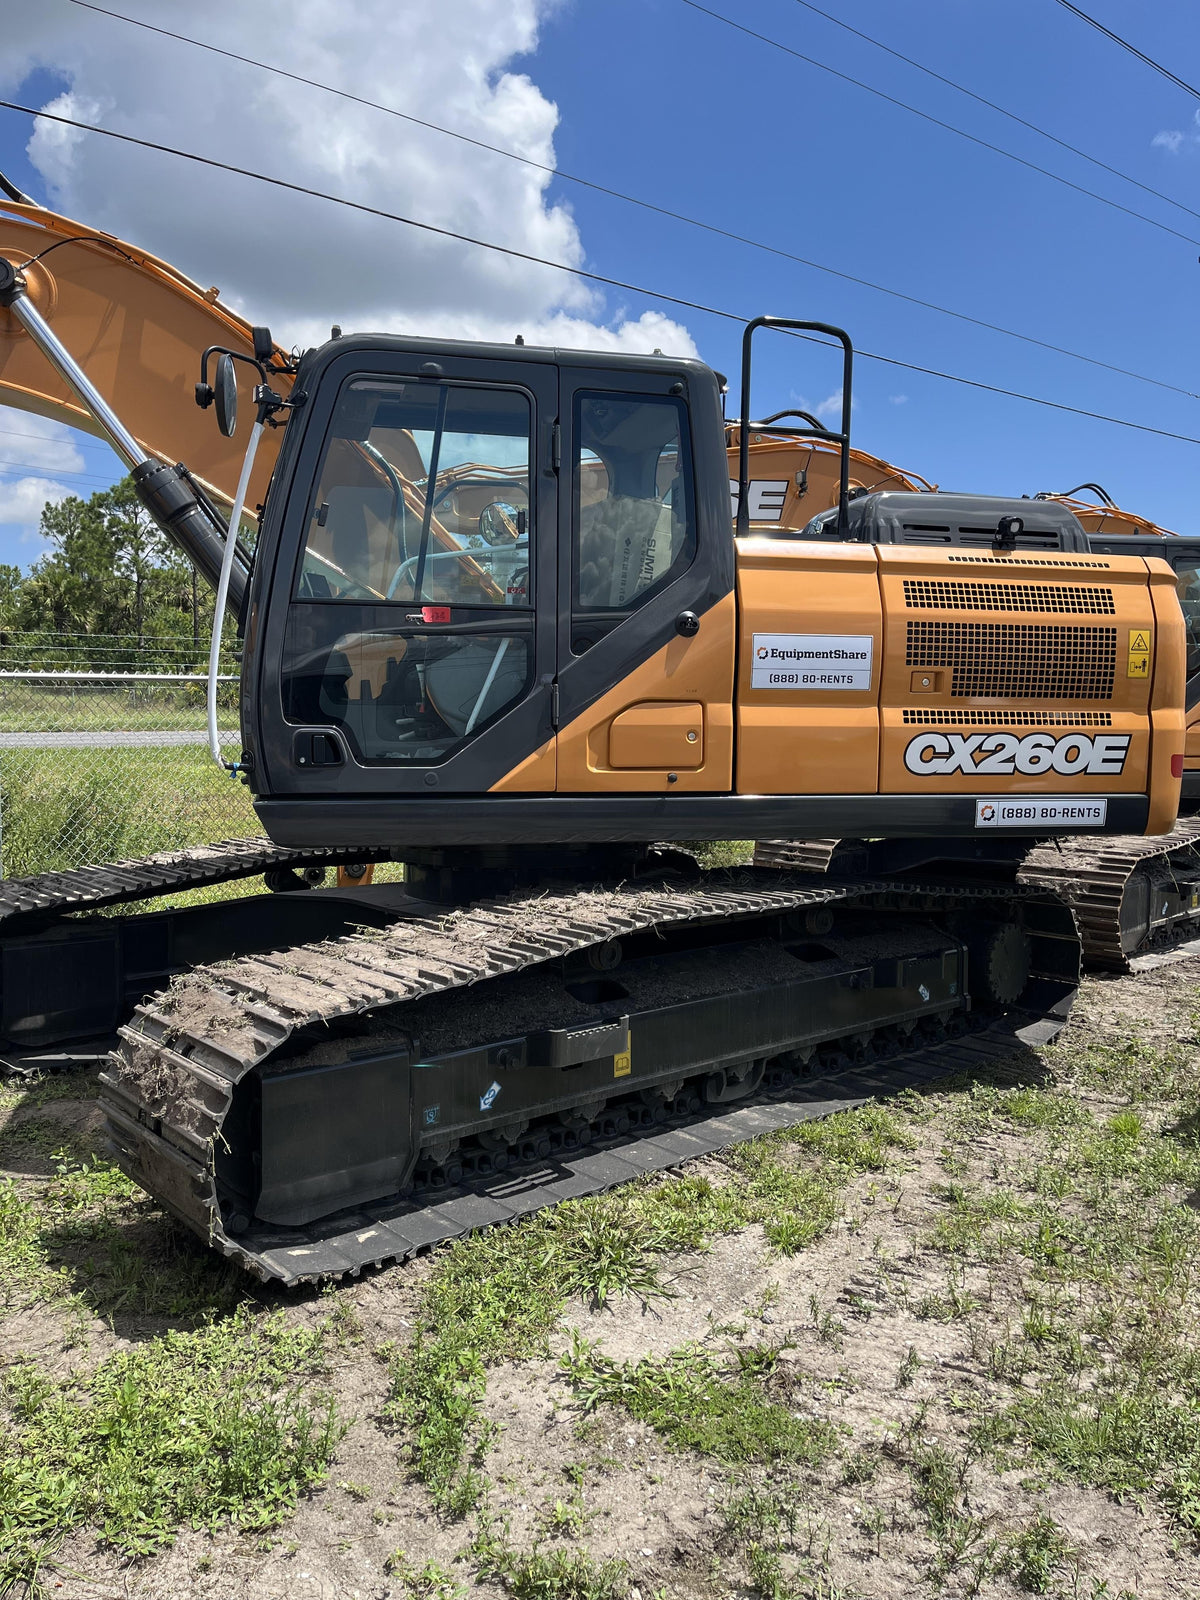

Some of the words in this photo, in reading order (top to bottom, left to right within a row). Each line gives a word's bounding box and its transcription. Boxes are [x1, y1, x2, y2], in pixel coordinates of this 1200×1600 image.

[643, 538, 657, 587] SUMIT
[770, 648, 867, 661] EquipmentShare
[769, 673, 799, 684] (888)
[802, 674, 854, 684] 80-RENTS
[903, 731, 1133, 776] CX260E
[1001, 807, 1037, 819] (888)
[1040, 807, 1101, 819] 80-RENTS
